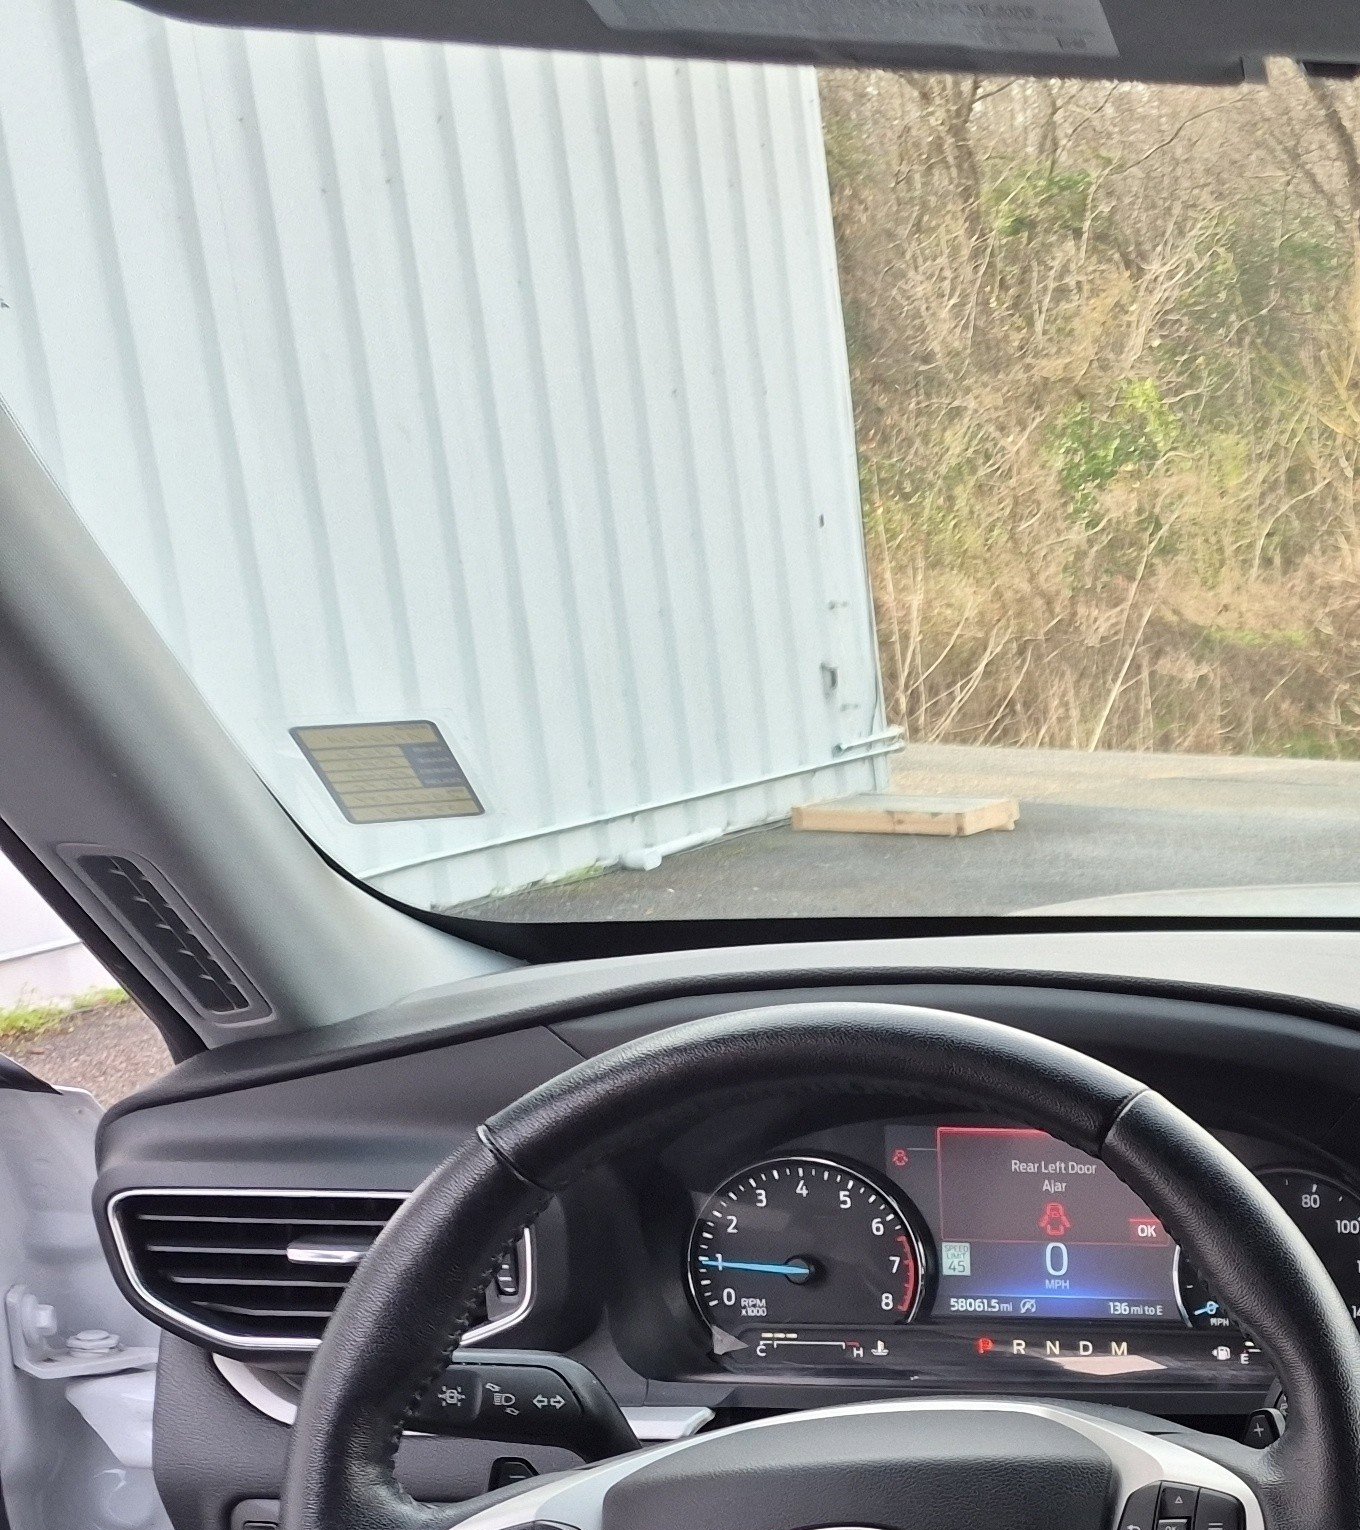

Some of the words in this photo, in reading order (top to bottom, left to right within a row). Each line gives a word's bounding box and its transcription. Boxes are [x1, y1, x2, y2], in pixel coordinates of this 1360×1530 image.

[1011, 1160, 1038, 1173] Rear
[1042, 1160, 1066, 1174] Left
[1068, 1161, 1097, 1175] Door
[795, 1179, 809, 1198] 4
[1042, 1179, 1067, 1194] Ajar
[755, 1189, 767, 1207] 3
[838, 1190, 852, 1209] 5
[1301, 1194, 1320, 1209] 80
[726, 1215, 738, 1234] 2
[871, 1217, 884, 1236] 6
[1137, 1224, 1156, 1237] OK
[1336, 1219, 1359, 1235] 100
[944, 1244, 969, 1252] SPEED
[889, 1256, 900, 1274] 7
[948, 1260, 966, 1273] 45
[1045, 1242, 1069, 1276] 0
[1045, 1279, 1070, 1290] MPH
[722, 1288, 736, 1306] 0
[741, 1298, 766, 1307] RPM
[881, 1292, 894, 1311] 8
[950, 1298, 999, 1312] 58061.5
[1000, 1301, 1013, 1311] mi
[1109, 1301, 1129, 1315] 136
[1130, 1304, 1143, 1315] mi
[1144, 1305, 1156, 1315] to
[1156, 1305, 1163, 1315] E
[1210, 1317, 1230, 1327] MPH
[756, 1345, 767, 1357] C
[853, 1346, 864, 1358] H
[979, 1338, 993, 1354] P
[1012, 1339, 1026, 1355] R
[1045, 1340, 1060, 1355] N
[1078, 1340, 1093, 1356] D
[1111, 1341, 1128, 1356] M
[1240, 1353, 1250, 1365] E
